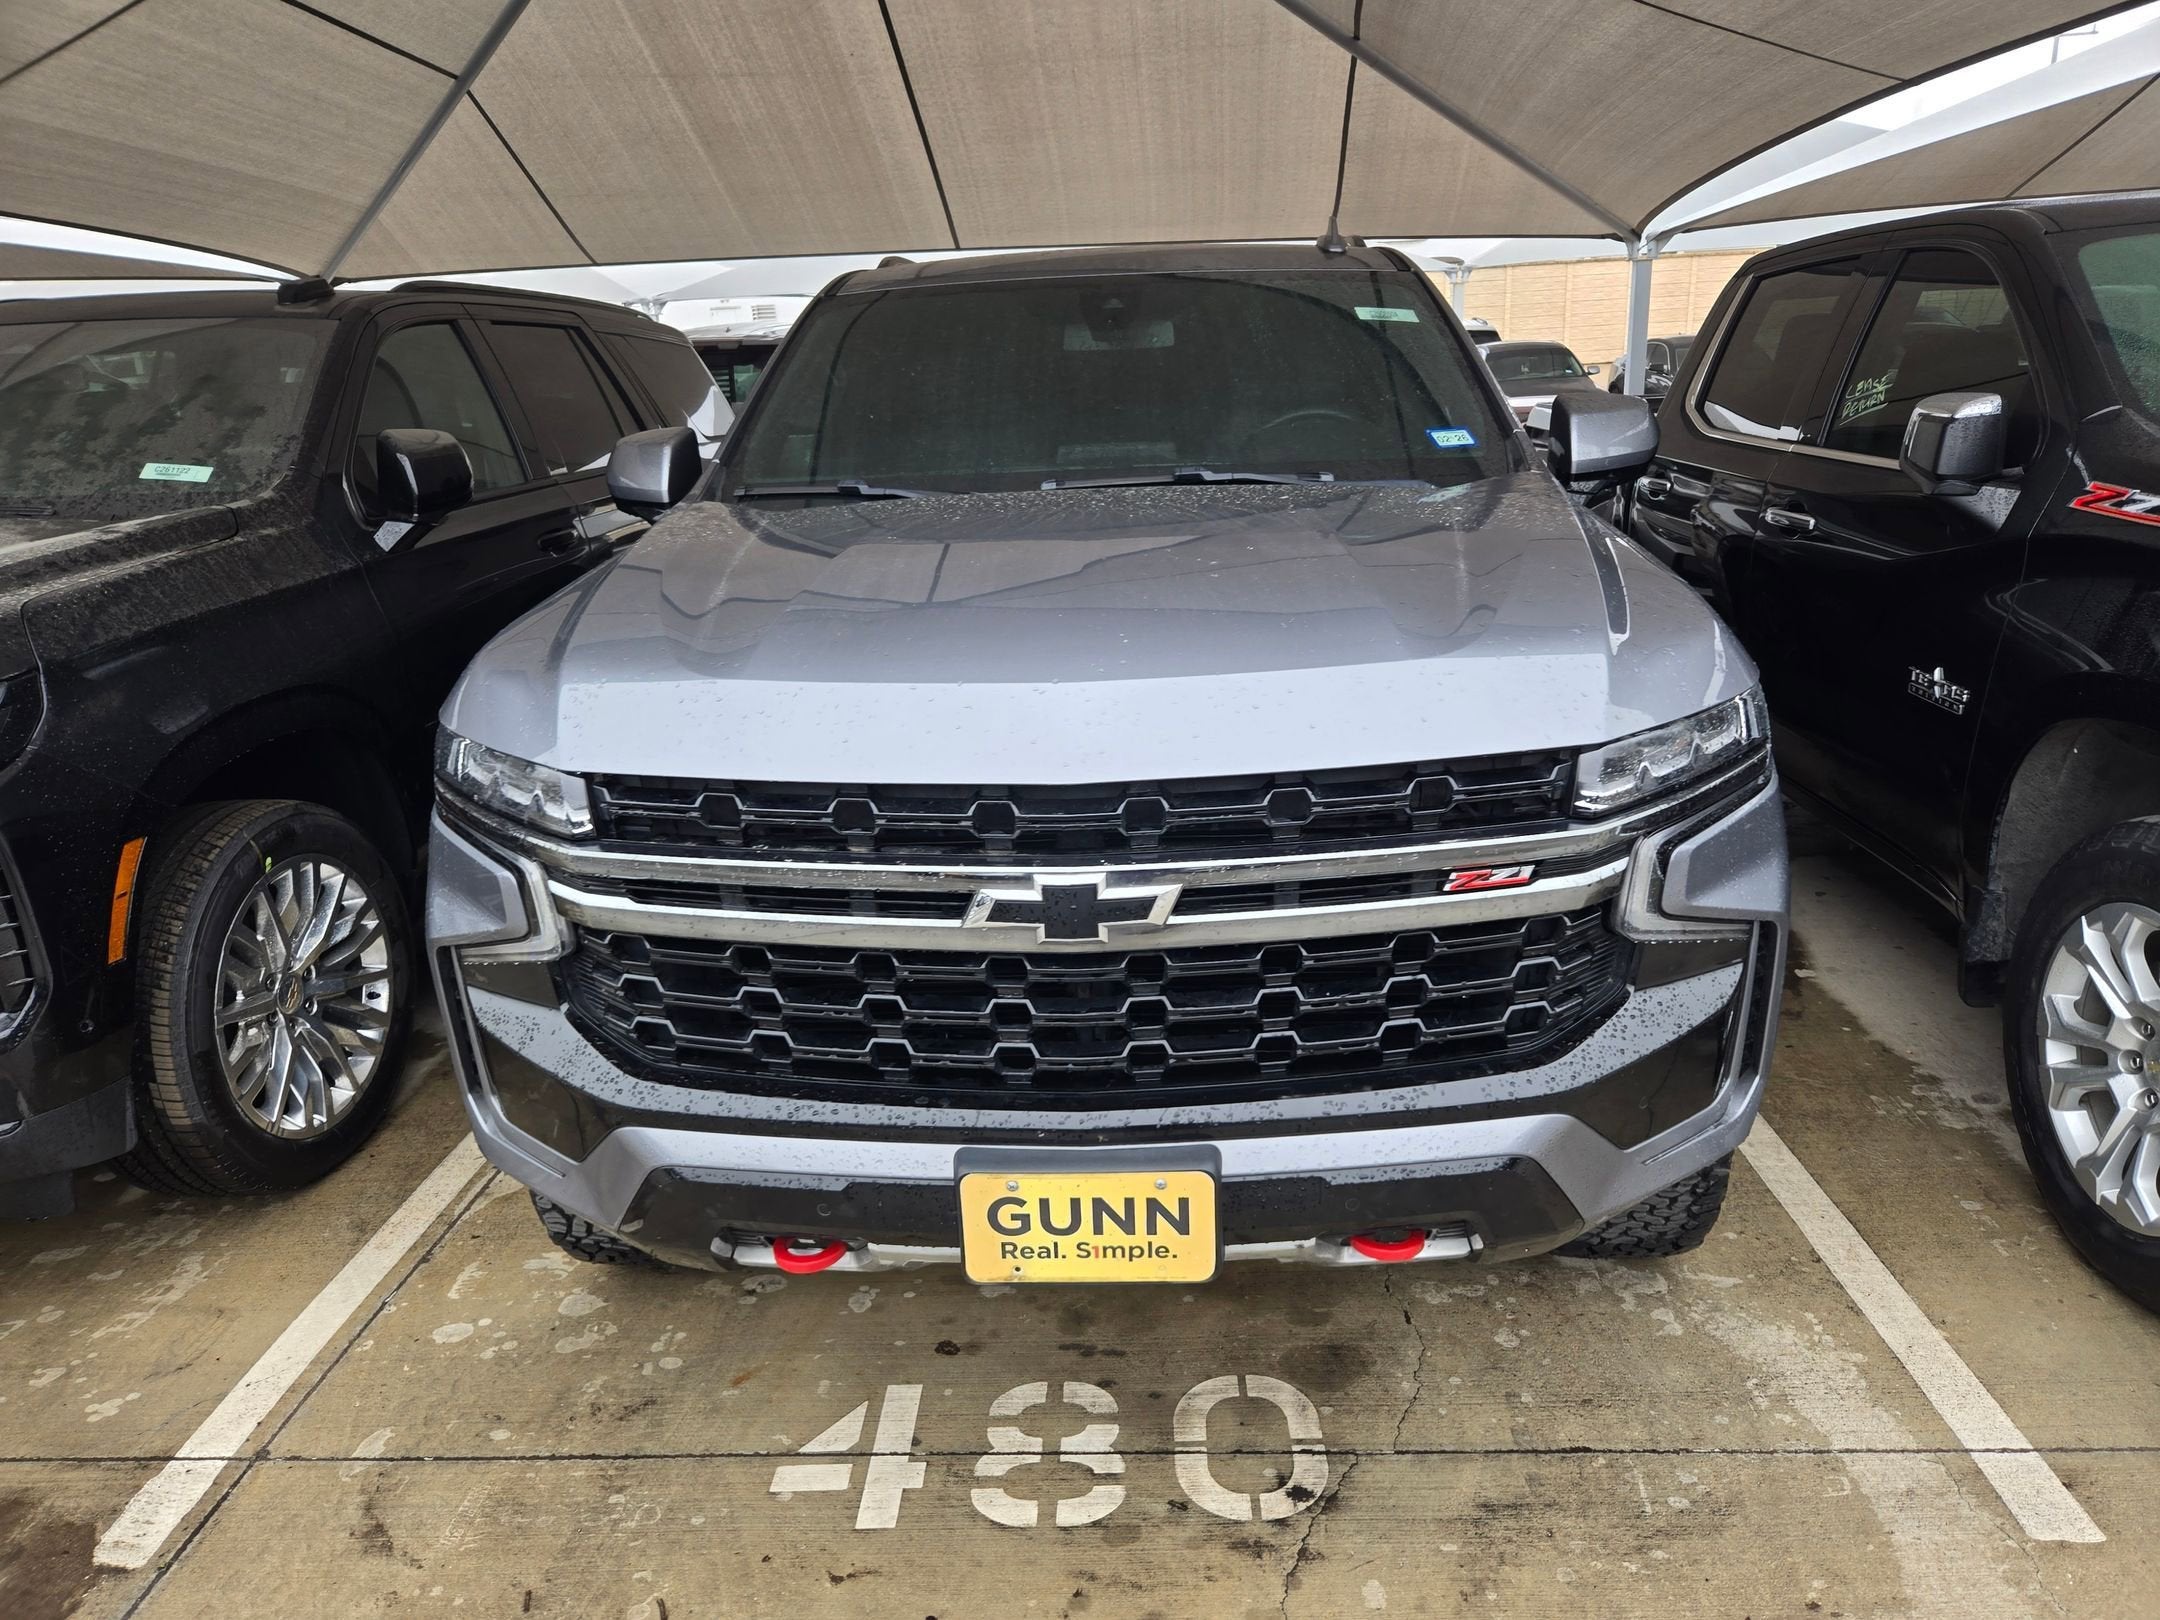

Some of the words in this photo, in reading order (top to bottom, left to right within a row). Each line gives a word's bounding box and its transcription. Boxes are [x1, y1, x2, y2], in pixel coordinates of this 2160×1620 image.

[1841, 389, 1885, 419] RETURN
[2067, 481, 2160, 527] Z7
[1443, 864, 1536, 892] Z71
[986, 1196, 1191, 1237] GUNN
[1001, 1241, 1067, 1260] Real.
[769, 1374, 1330, 1530] 480
